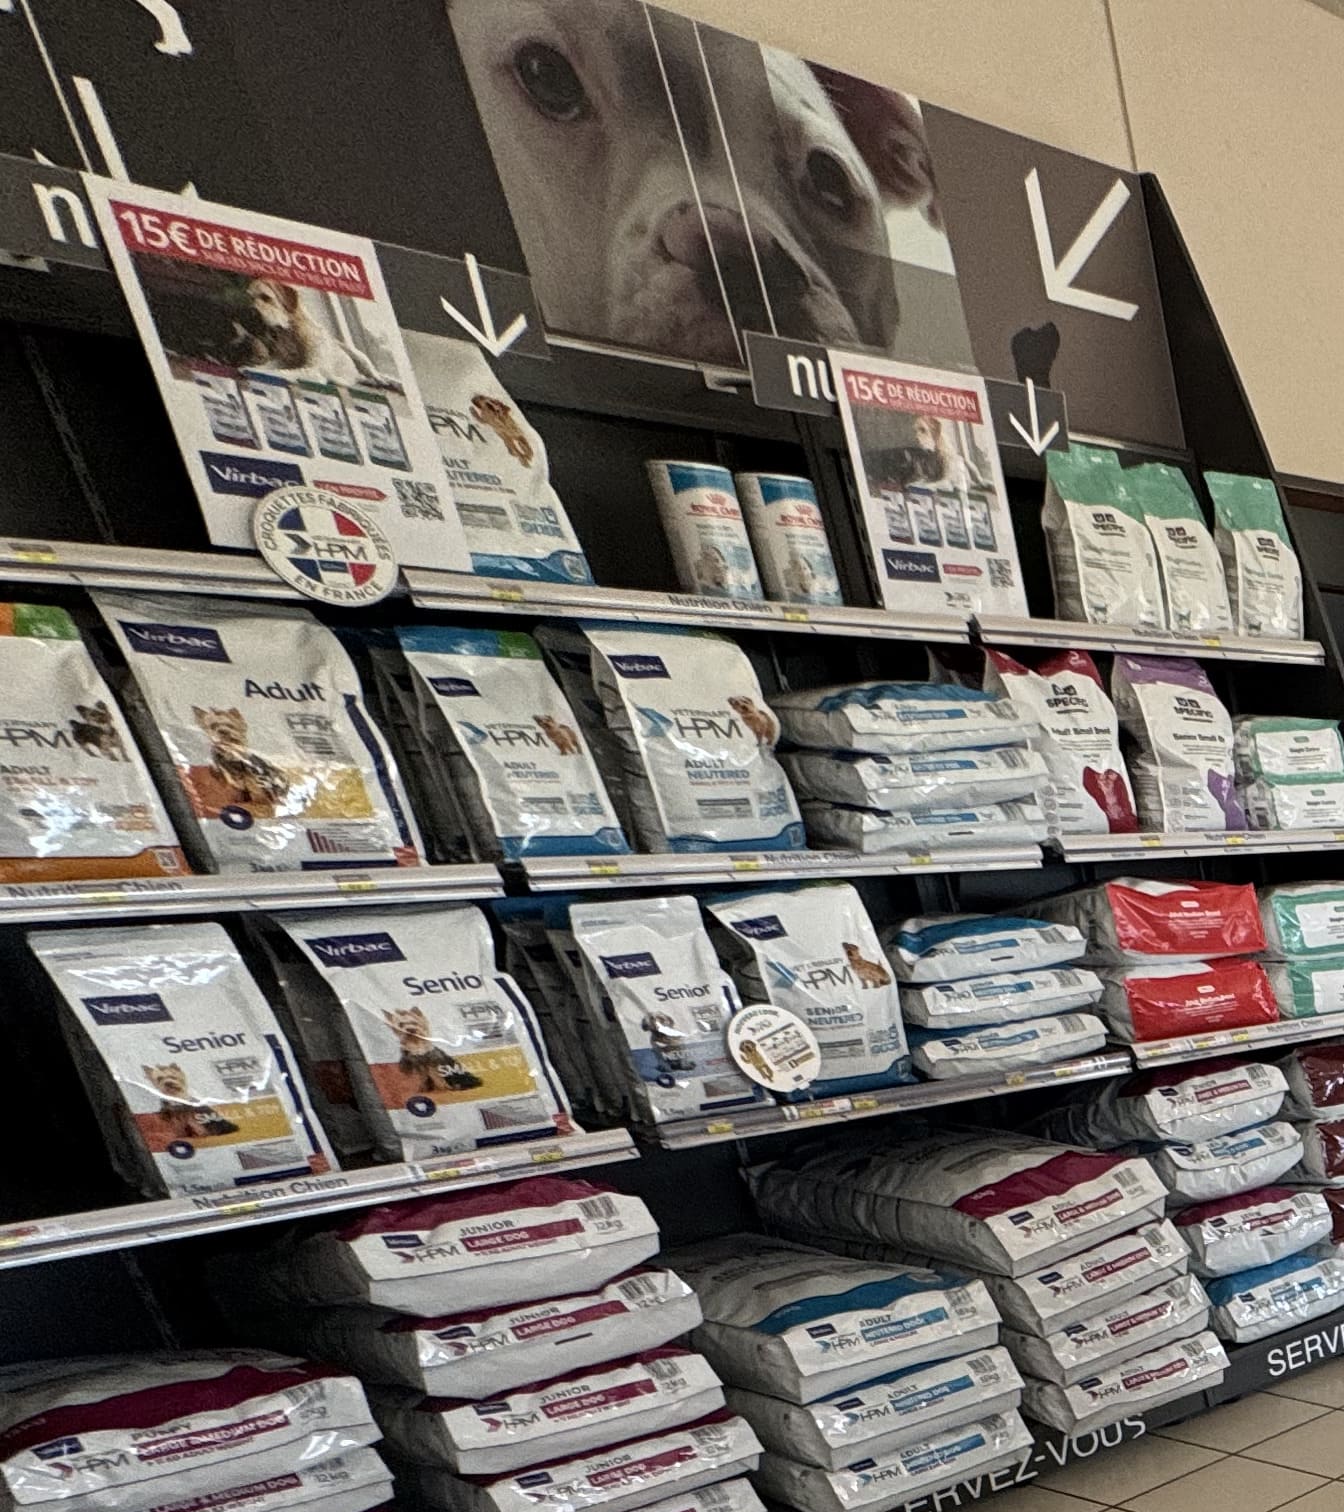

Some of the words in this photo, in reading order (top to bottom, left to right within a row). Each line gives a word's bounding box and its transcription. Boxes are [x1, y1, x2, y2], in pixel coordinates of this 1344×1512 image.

[119, 208, 199, 256] 15€
[198, 227, 228, 254] DE
[233, 235, 362, 283] RÉDUCTION
[847, 374, 888, 405] 15€
[888, 383, 905, 401] DE
[906, 385, 978, 412] RÉDUCTION
[429, 415, 489, 445] PM
[446, 470, 503, 486] UTERED
[887, 555, 936, 575] Virbac
[293, 572, 317, 593] EN
[320, 578, 387, 603] FRANCE
[126, 627, 218, 649] Virbac
[244, 678, 325, 702] Adult
[488, 729, 549, 749] HPM
[673, 717, 744, 741] HPM
[686, 768, 750, 781] NEUTERED
[315, 940, 392, 957] Virbac
[402, 971, 485, 996] Senio
[653, 984, 712, 1002] Senior
[93, 1001, 162, 1015] Virbac
[163, 1032, 247, 1054] Senior
[289, 1176, 348, 1195] Chien
[459, 1219, 515, 1237] JUNIOR
[509, 1306, 561, 1325] JUNIOR
[540, 1383, 591, 1403] JUNIOR
[131, 1422, 192, 1441] PUPPY
[584, 1454, 633, 1474] JUNIOR
